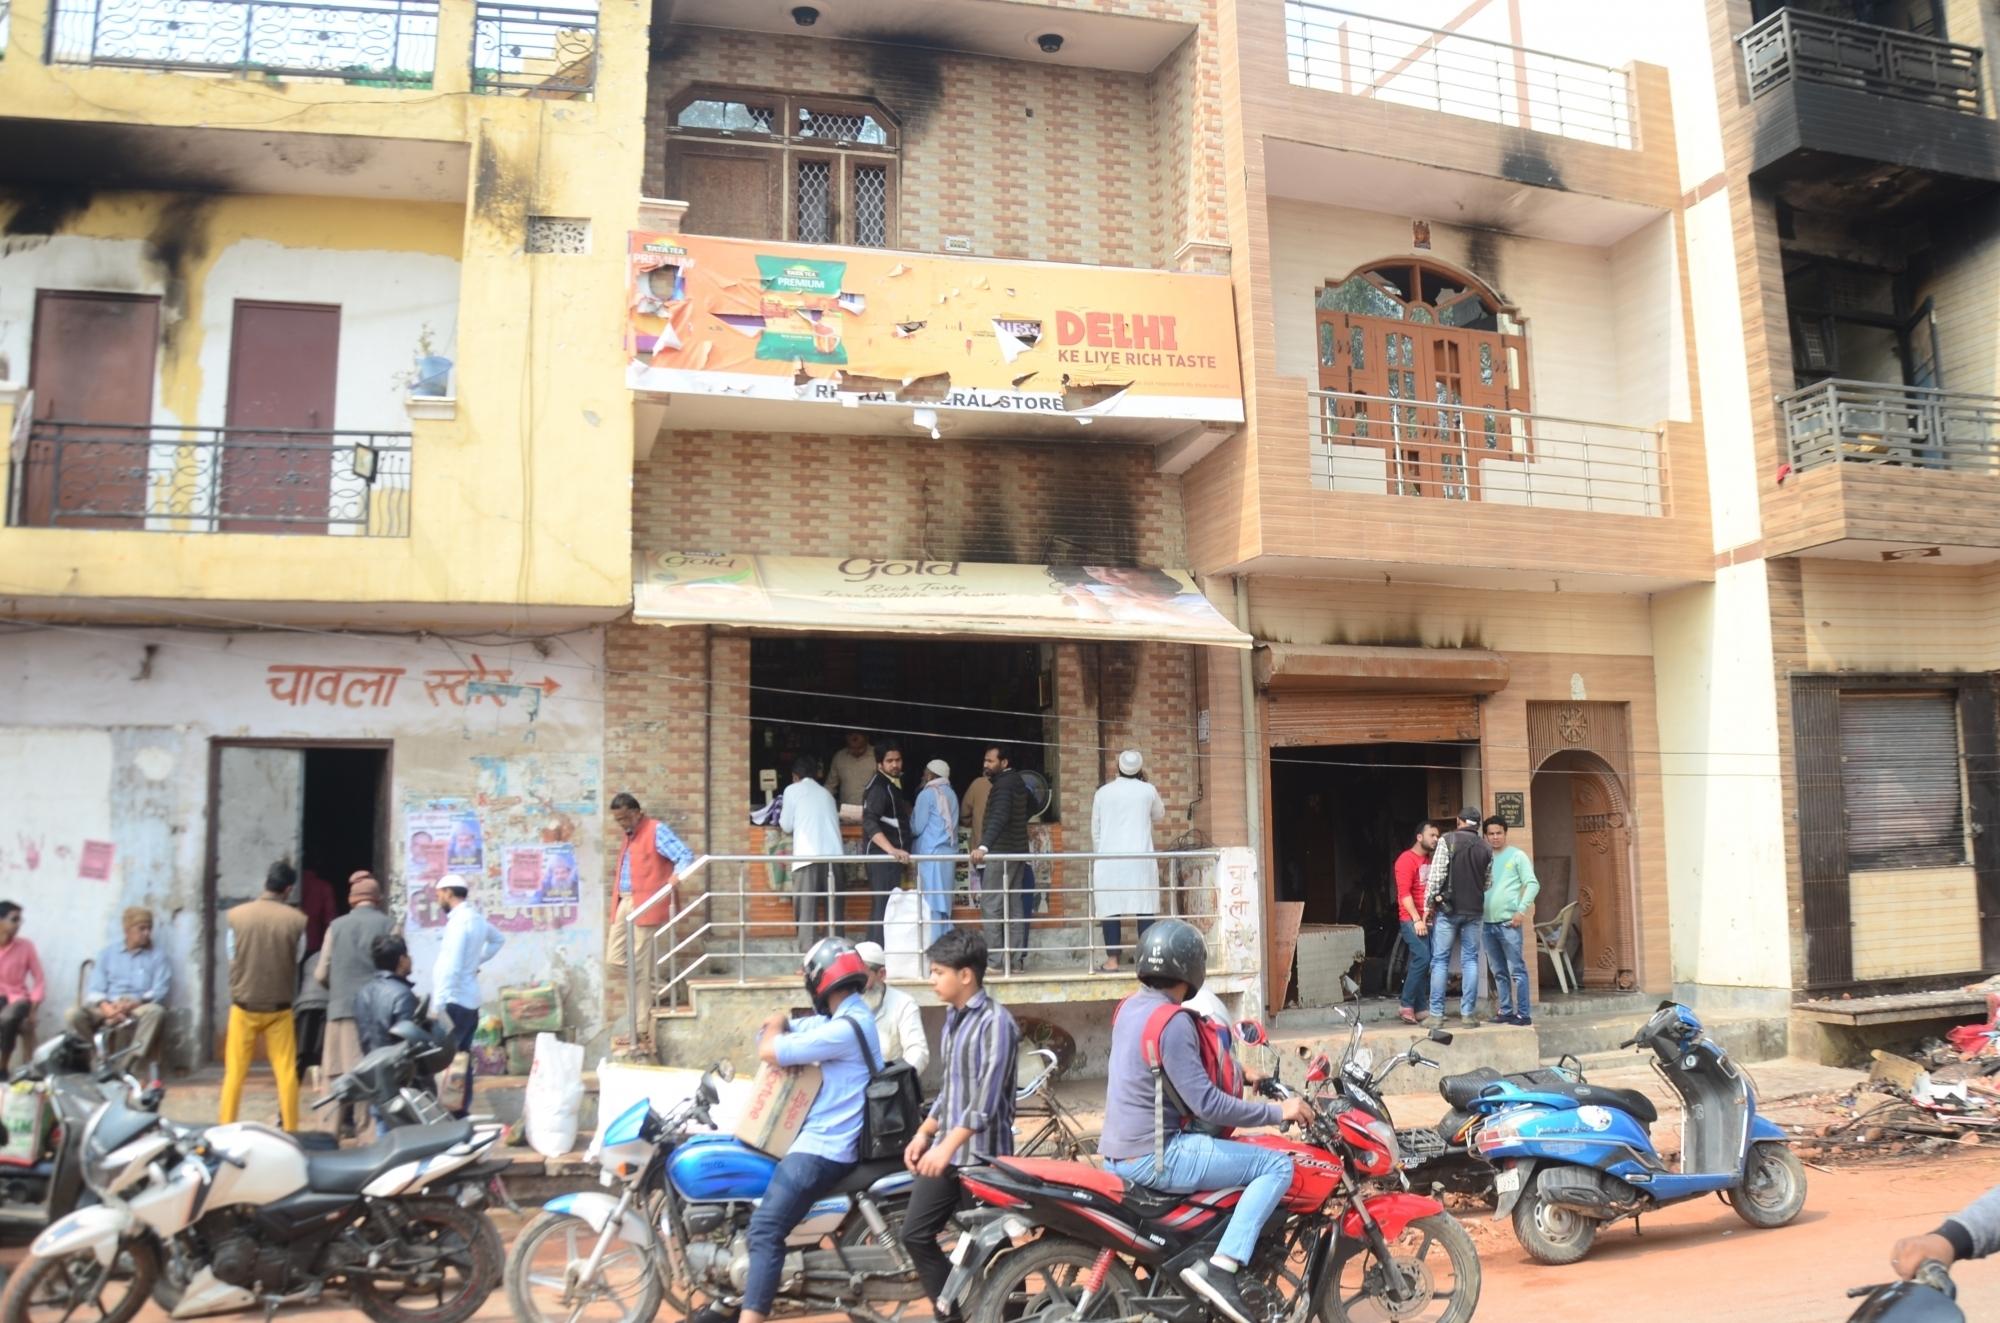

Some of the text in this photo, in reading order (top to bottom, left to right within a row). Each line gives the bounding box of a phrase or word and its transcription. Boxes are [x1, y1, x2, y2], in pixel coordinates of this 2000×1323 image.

[778, 277, 825, 289] PREMIUM
[1055, 310, 1178, 351] DELHI
[1058, 349, 1217, 370] KE LIYE RICH TASTE
[266, 665, 407, 708] चावला
